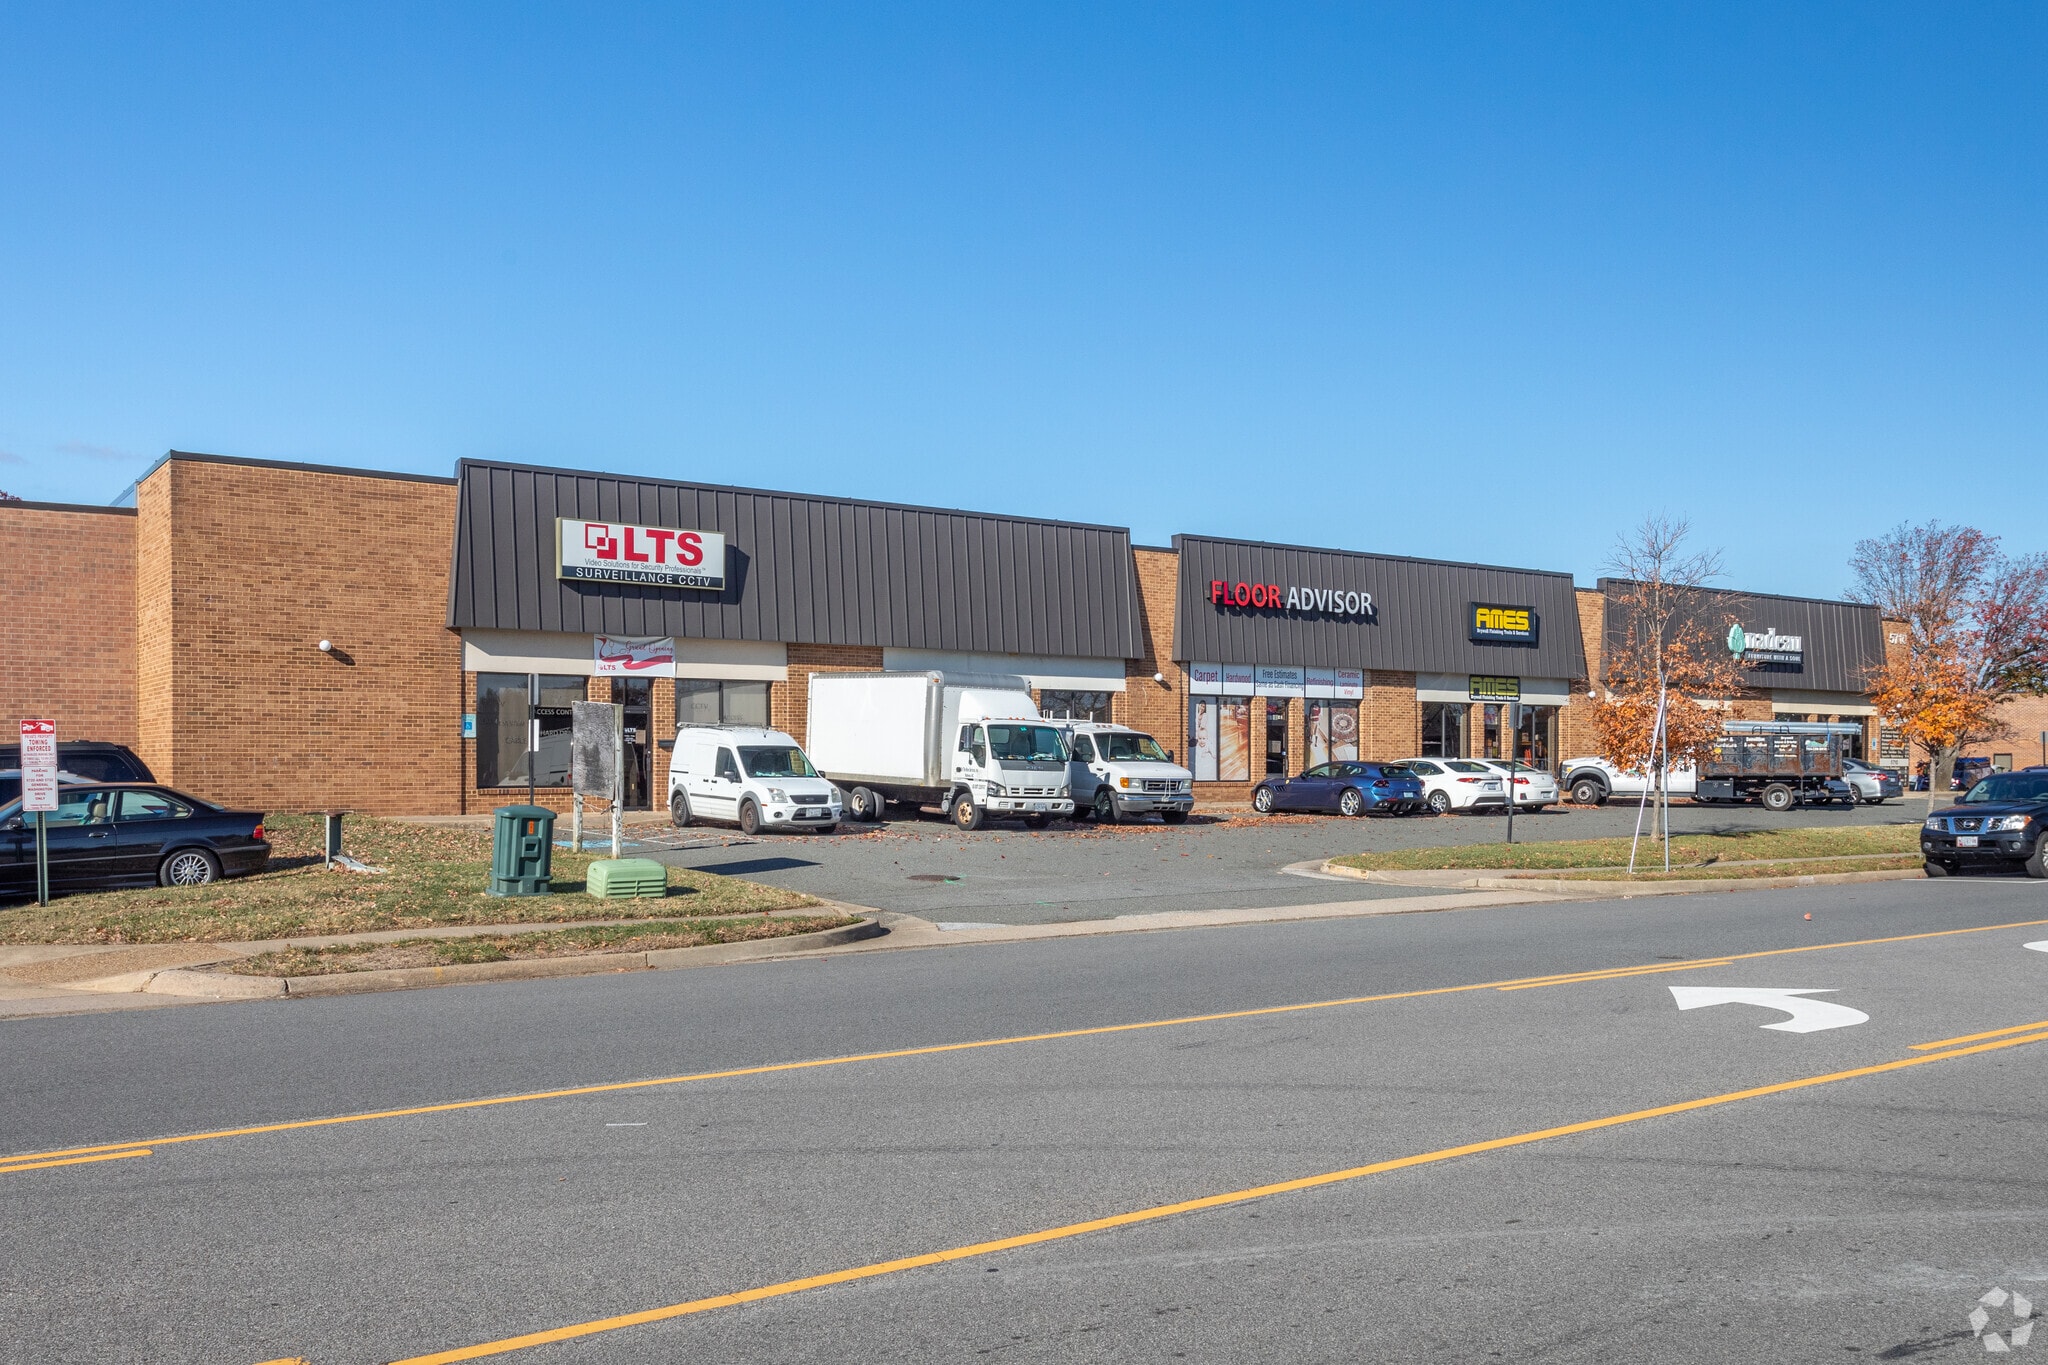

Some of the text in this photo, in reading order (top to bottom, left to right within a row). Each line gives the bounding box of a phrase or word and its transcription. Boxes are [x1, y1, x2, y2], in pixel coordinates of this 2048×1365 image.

[624, 527, 704, 566] LTS
[584, 558, 602, 566] Video
[602, 560, 630, 570] Solutions
[640, 562, 664, 572] Security
[664, 564, 702, 574] Professionals
[576, 567, 711, 586] SURVEILLANCE CCTV
[1211, 580, 1373, 615] FLOOR ADVISOR
[1476, 608, 1530, 630] AMES
[1194, 669, 1218, 684] Carpet
[1226, 672, 1251, 683] Hardwood
[1262, 669, 1298, 679] Free Estimates
[1307, 677, 1333, 687] Refinishing
[1338, 670, 1360, 679] Ceramic
[1470, 677, 1518, 696] AMES
